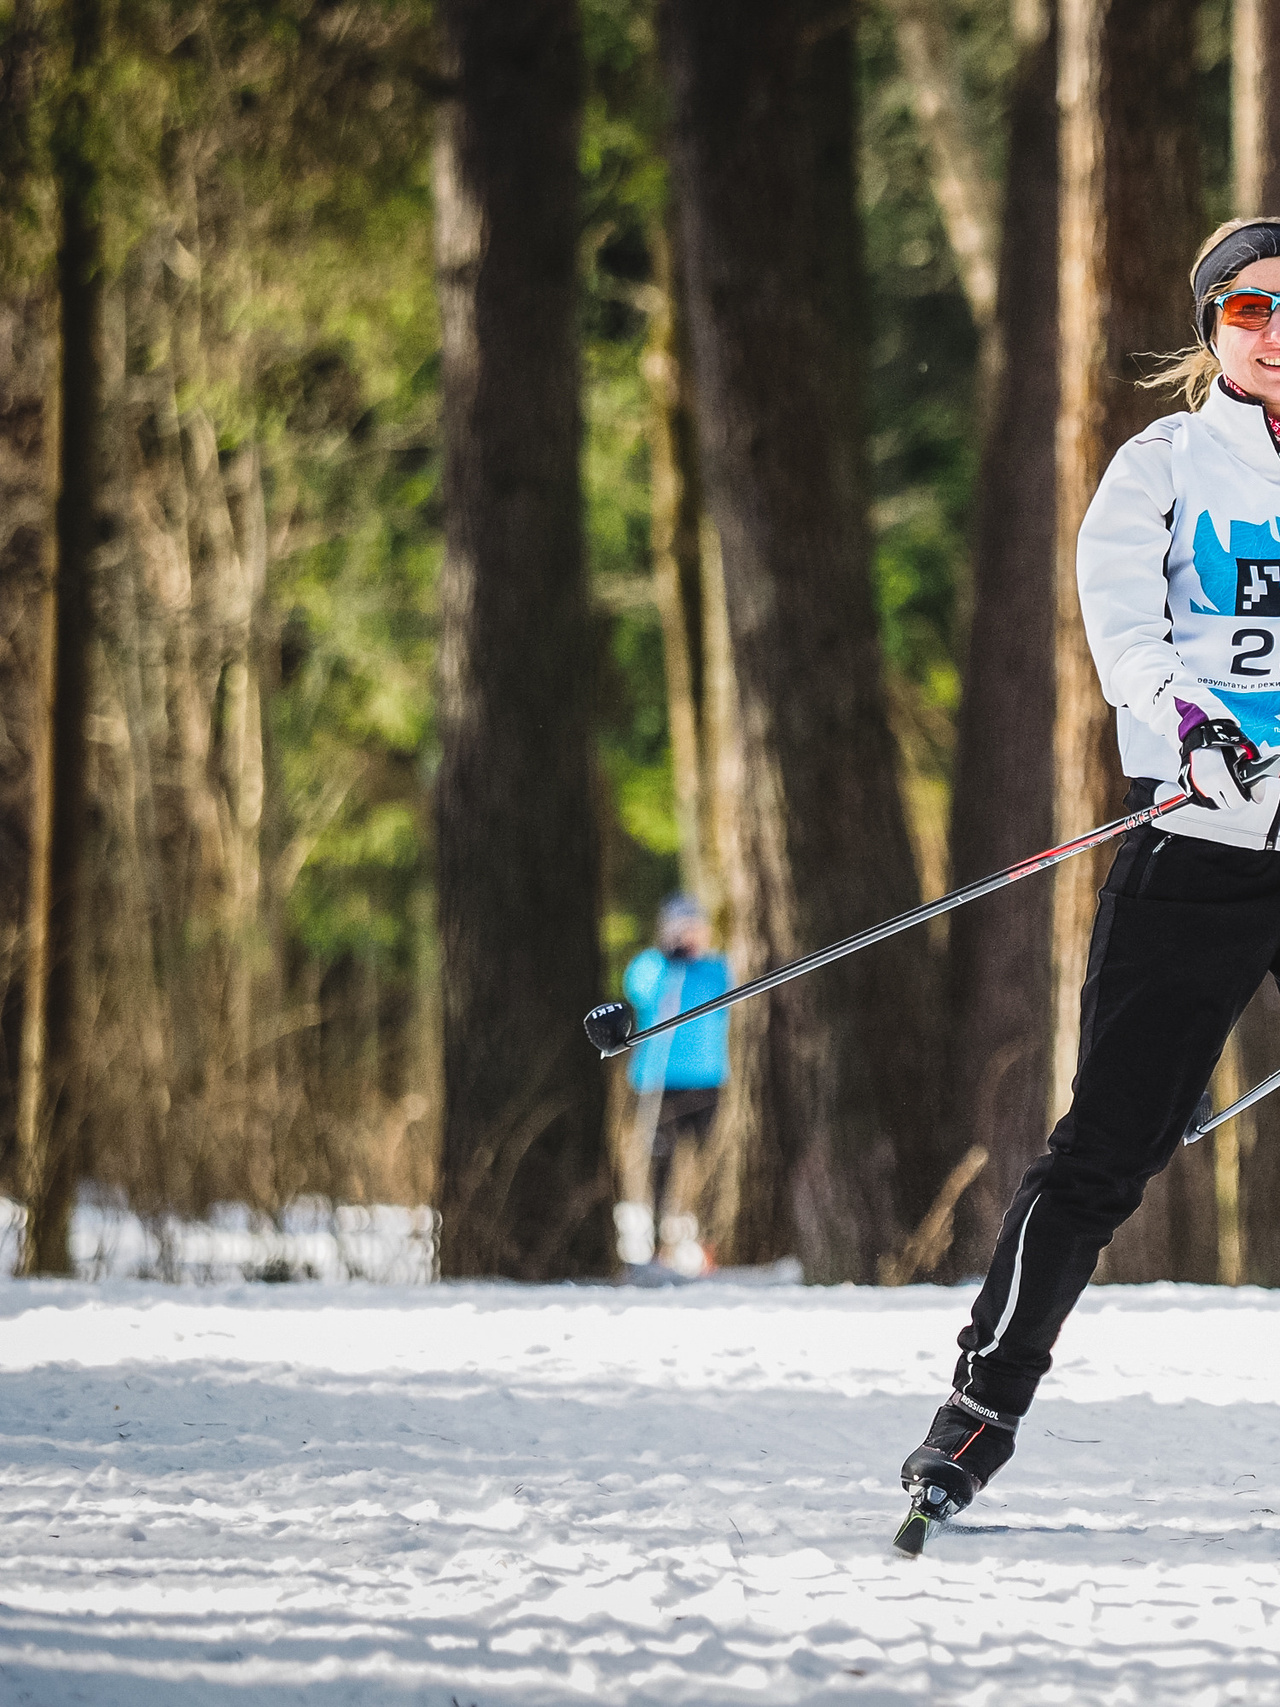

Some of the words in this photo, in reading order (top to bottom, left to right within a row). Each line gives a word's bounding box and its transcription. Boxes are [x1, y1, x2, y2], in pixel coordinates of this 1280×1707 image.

[1197, 677, 1248, 690] результаты
[1125, 804, 1163, 830] LEKI
[591, 1003, 623, 1020] LEKI
[960, 1394, 999, 1421] ROSSIGNOL
